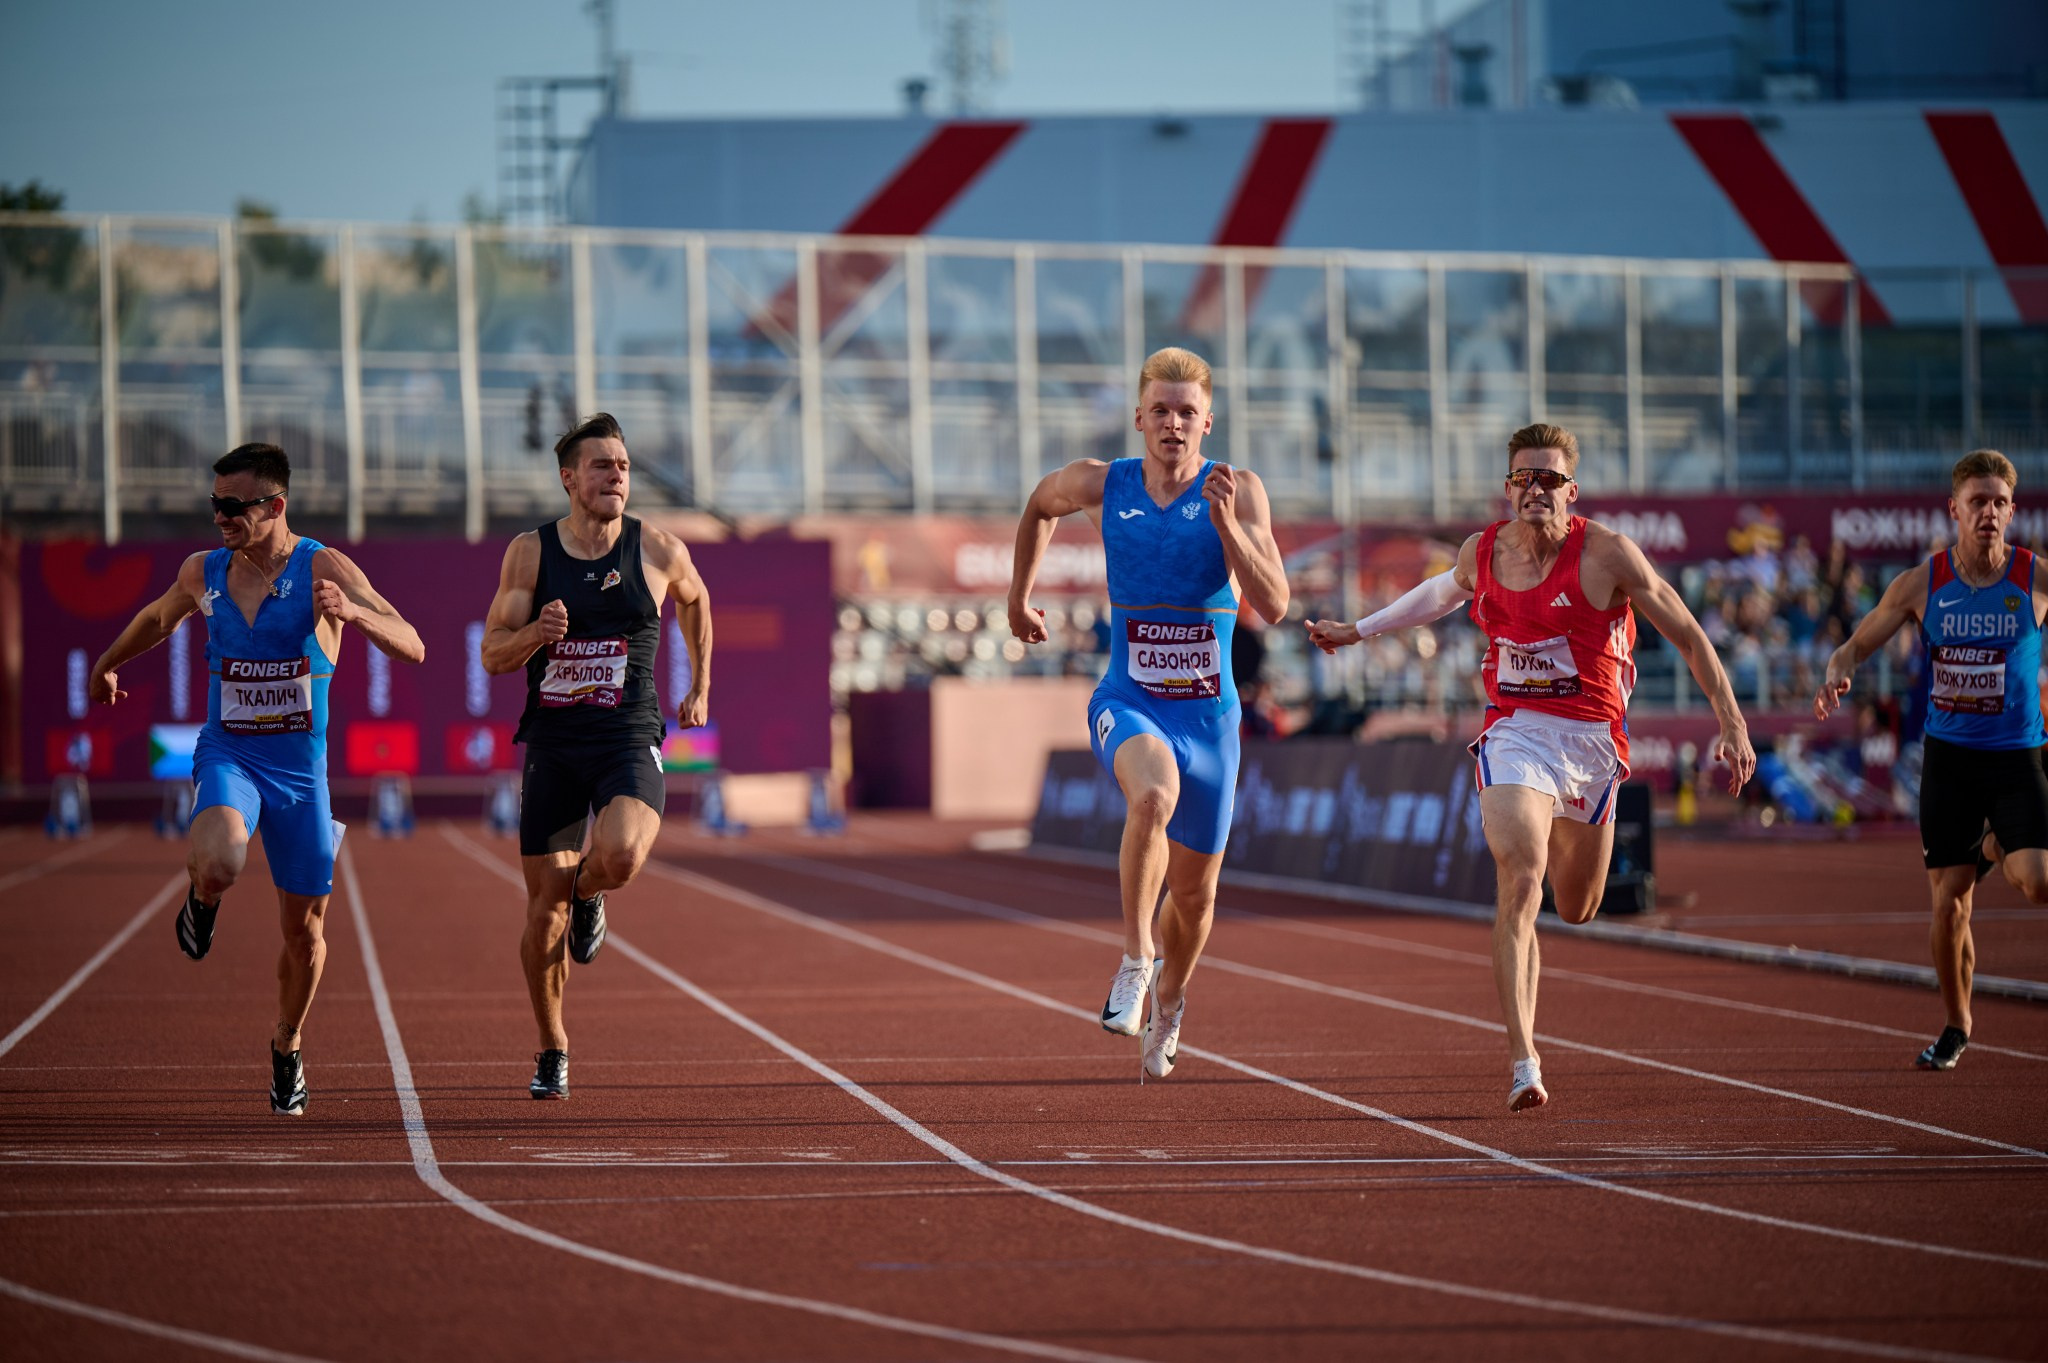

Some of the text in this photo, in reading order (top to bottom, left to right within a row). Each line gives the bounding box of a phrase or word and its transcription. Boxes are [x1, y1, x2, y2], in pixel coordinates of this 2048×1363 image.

[1832, 507, 1958, 548] ЮЖНА
[1137, 624, 1209, 640] FONBET
[1940, 613, 2019, 638] RUSSIA
[555, 641, 620, 656] FONBET
[1137, 650, 1211, 669] САЗОНОВ
[229, 661, 302, 677] FONBET
[553, 665, 614, 682] КРЫЛОВ
[1936, 668, 1998, 688] КОЖУХОВ
[236, 688, 298, 706] ТКАЛИЧ
[1140, 684, 1167, 693] РОЛЕВА
